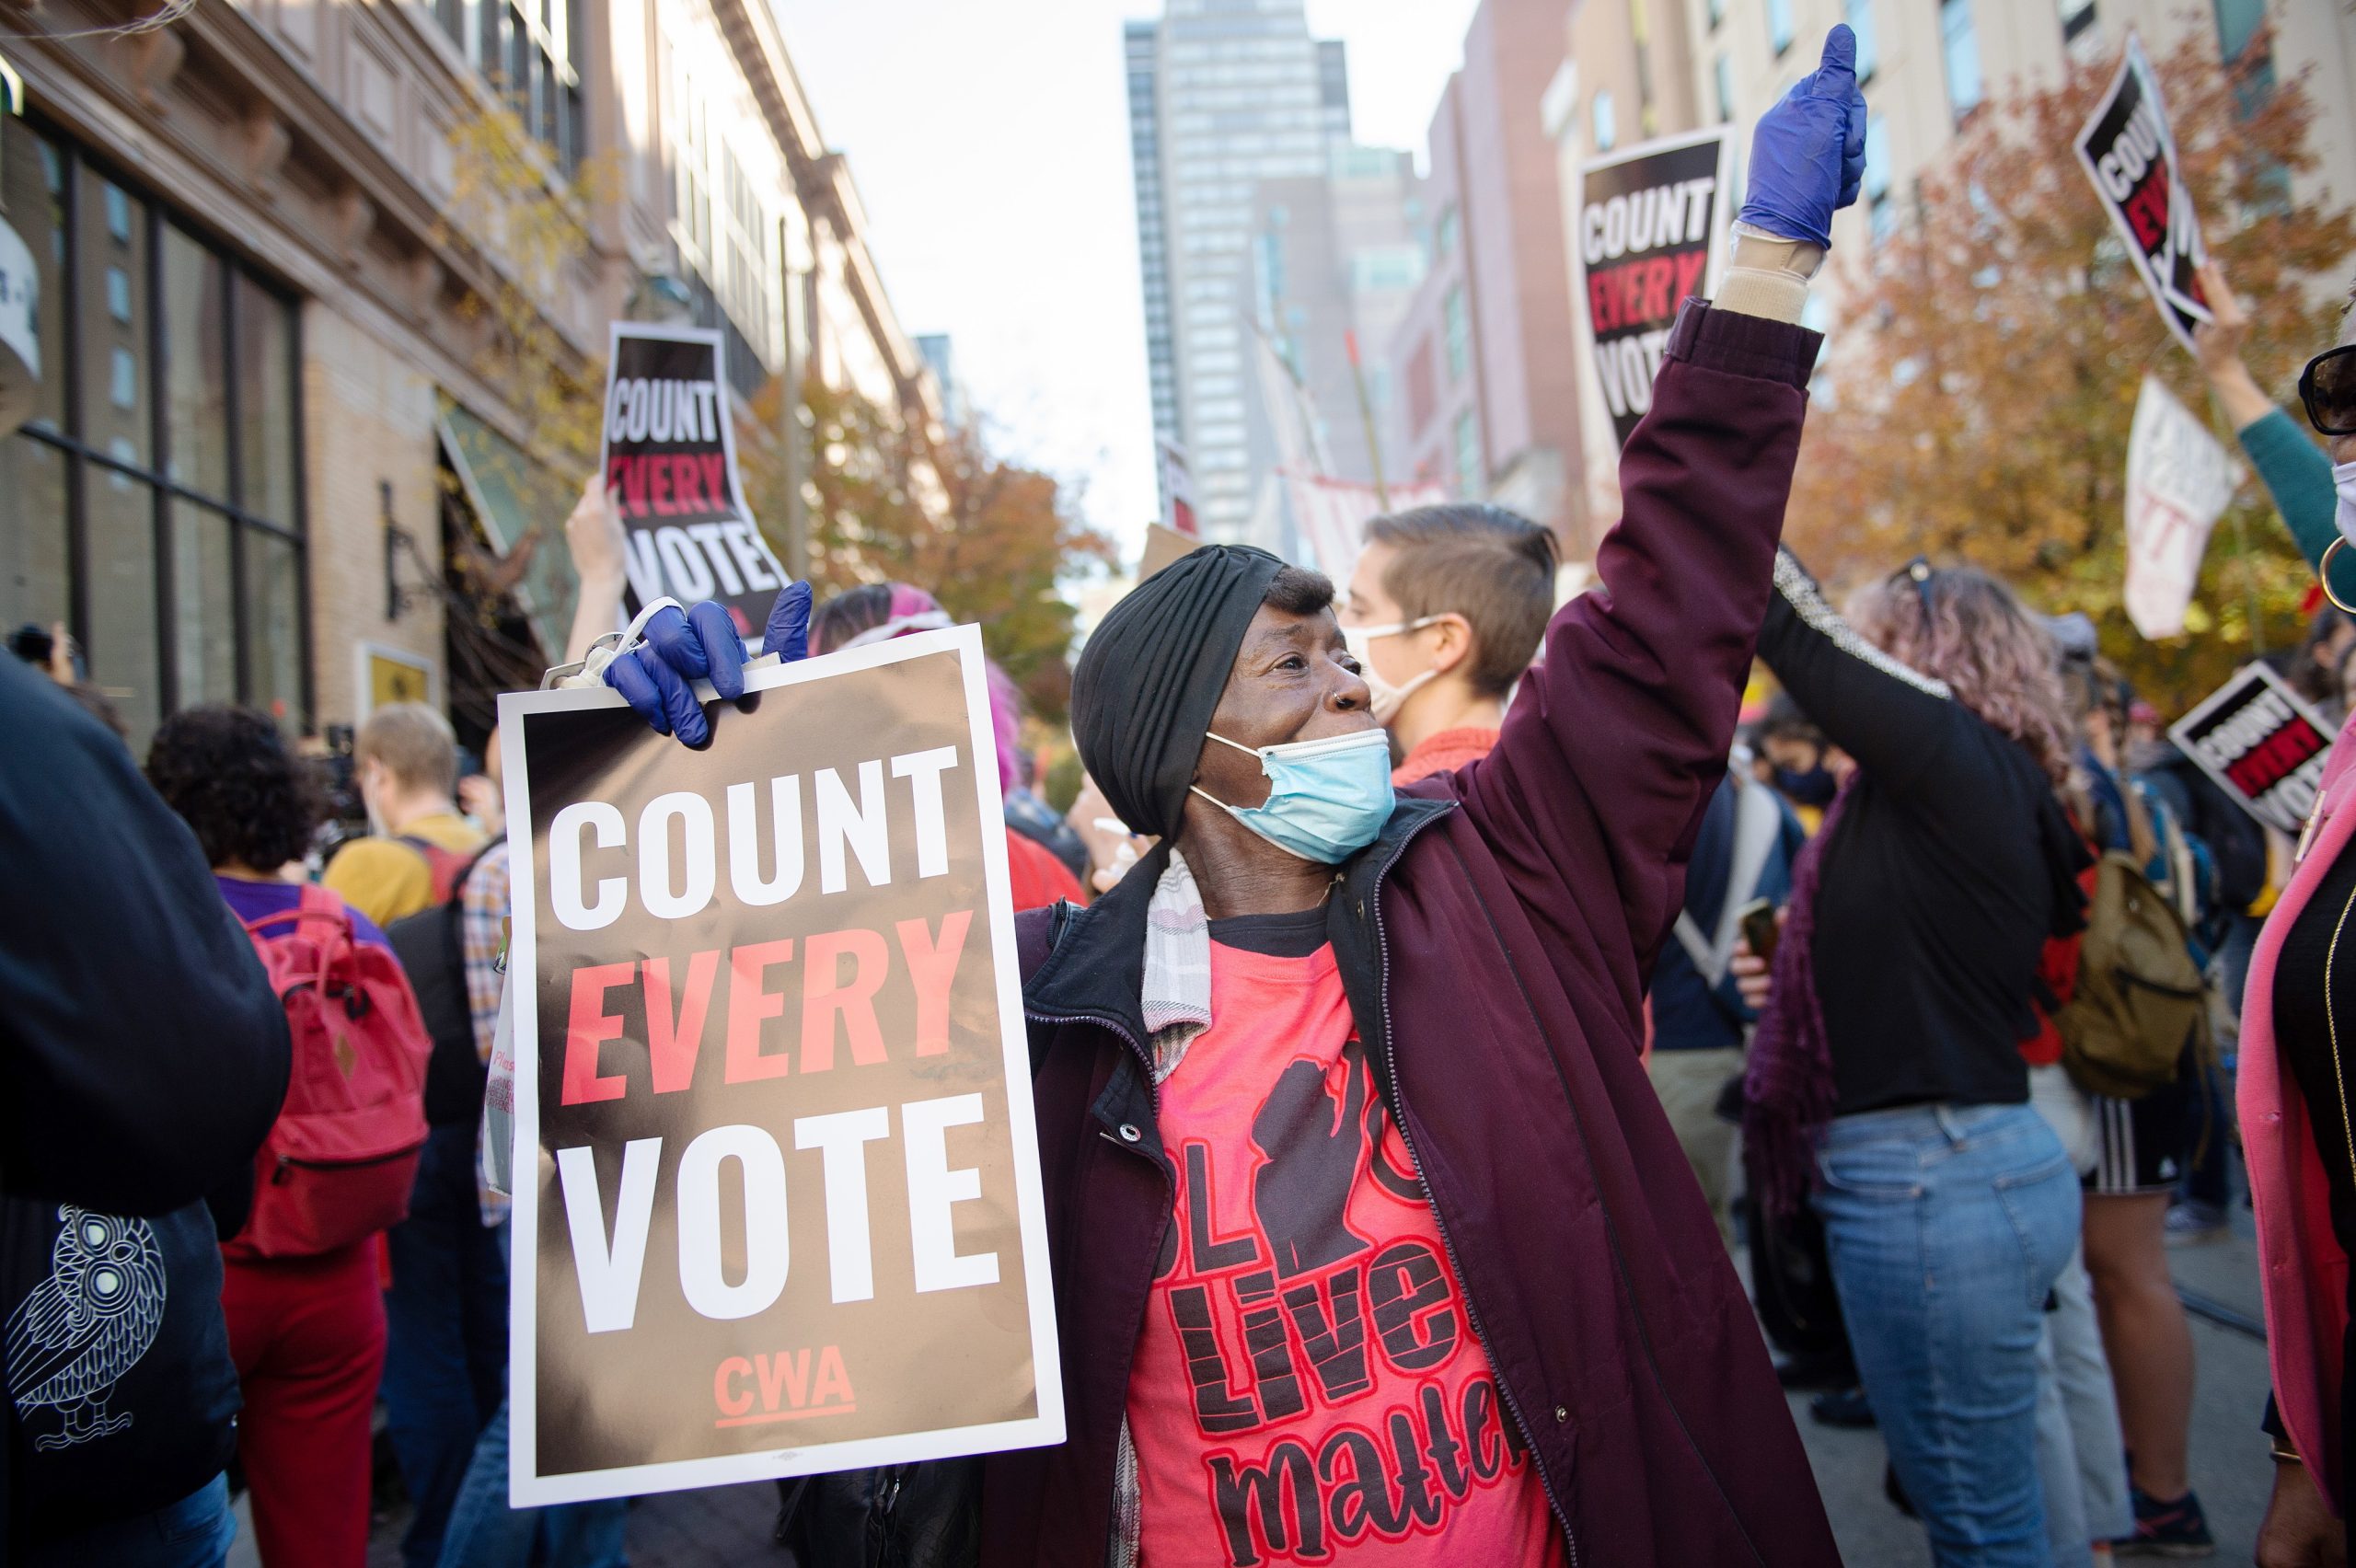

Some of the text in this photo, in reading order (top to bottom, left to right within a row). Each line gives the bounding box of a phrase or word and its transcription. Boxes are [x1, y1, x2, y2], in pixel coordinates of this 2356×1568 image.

[1583, 176, 1715, 265] COUNT
[1589, 250, 1707, 333] EVERY
[608, 377, 718, 444] COUNT
[1596, 329, 1670, 419] VOT
[624, 522, 782, 612] VOTE
[2195, 688, 2294, 772] COUNT
[549, 745, 958, 931] COUNT
[561, 910, 974, 1106] EVERY
[557, 1091, 1000, 1333] VOTE
[714, 1344, 854, 1418] CWA
[1170, 1240, 1482, 1434] Live
